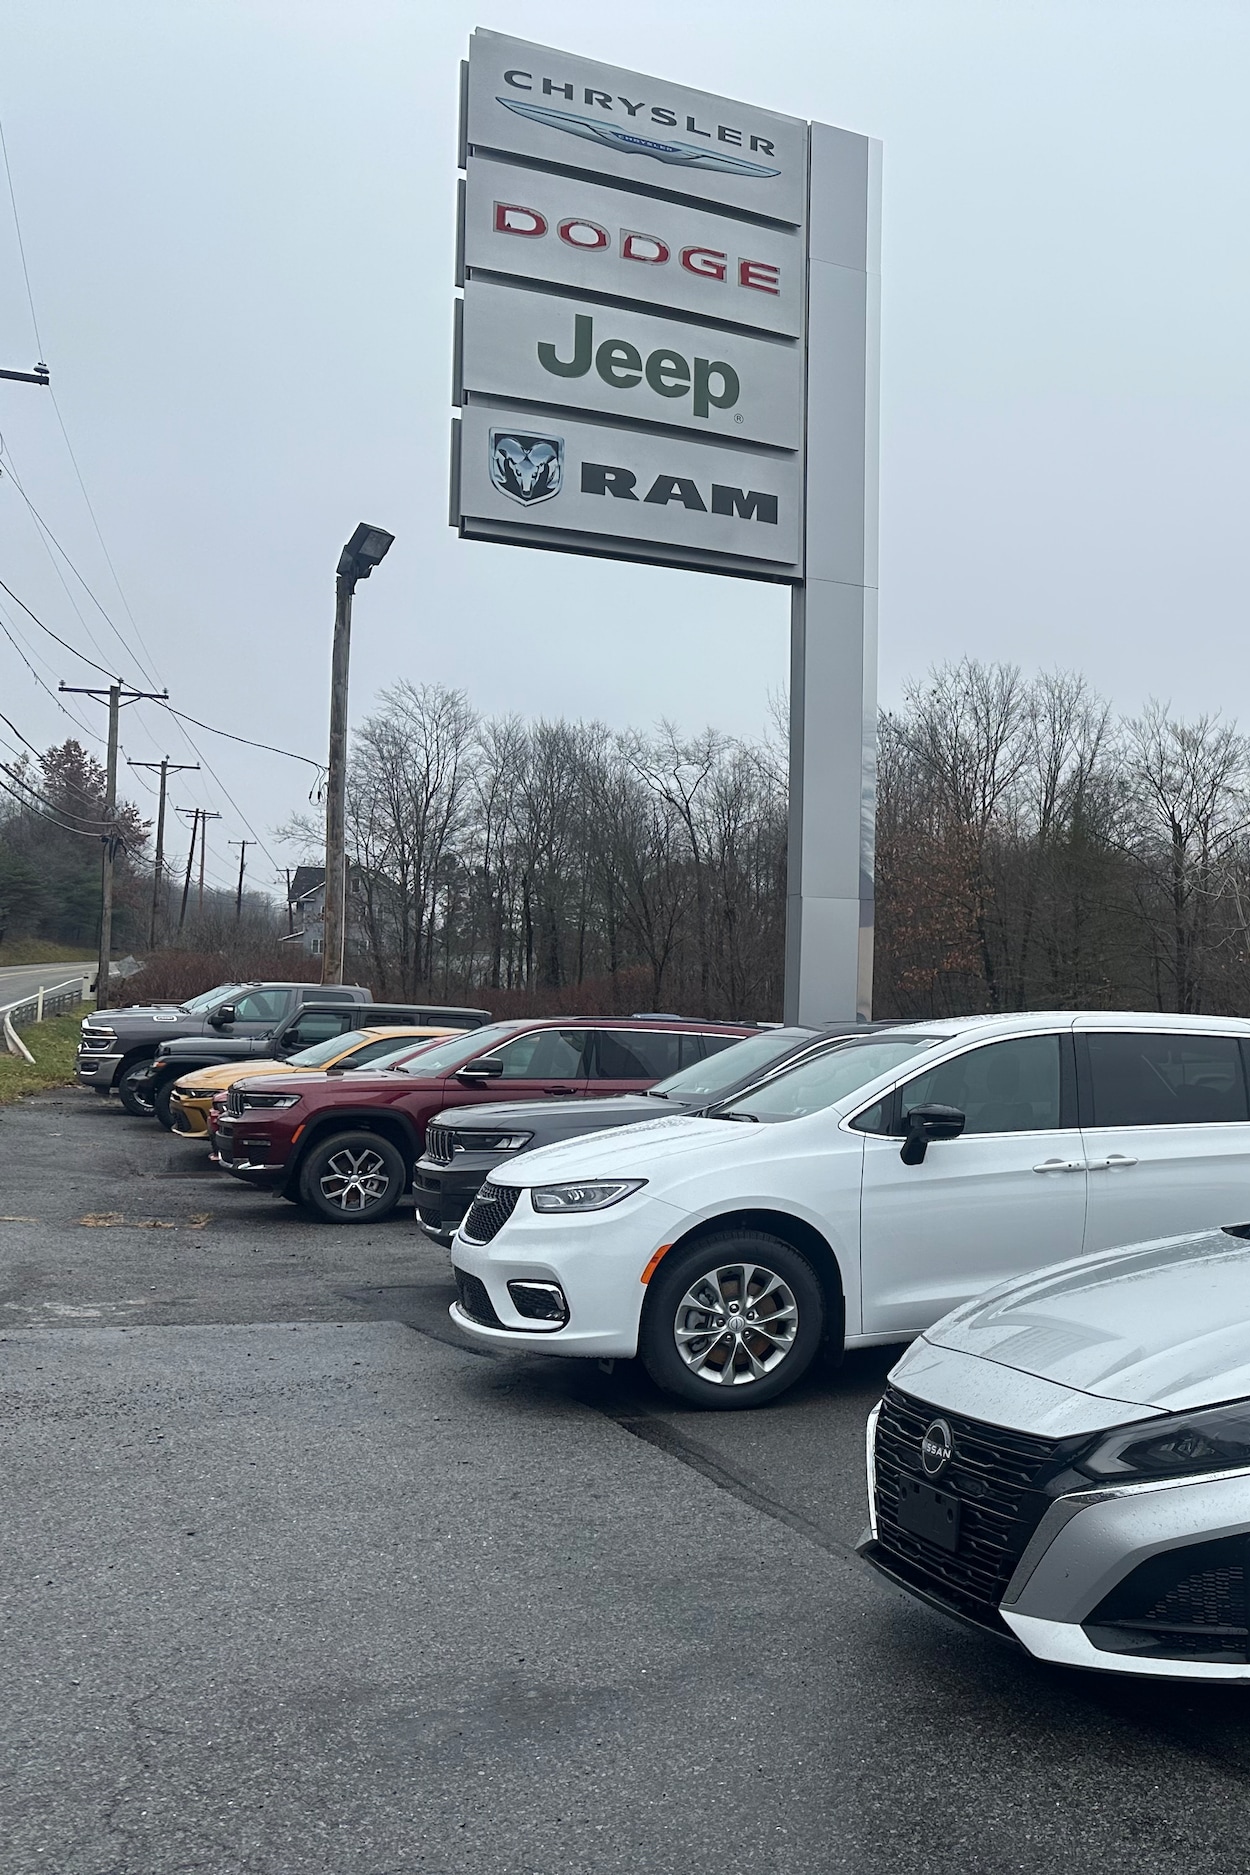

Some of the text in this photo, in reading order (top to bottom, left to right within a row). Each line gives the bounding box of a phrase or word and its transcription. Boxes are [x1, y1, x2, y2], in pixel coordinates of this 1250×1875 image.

[503, 70, 776, 157] CHRYSLER
[493, 200, 782, 297] DODGE
[537, 313, 740, 419] Jeep
[581, 461, 779, 526] RAM
